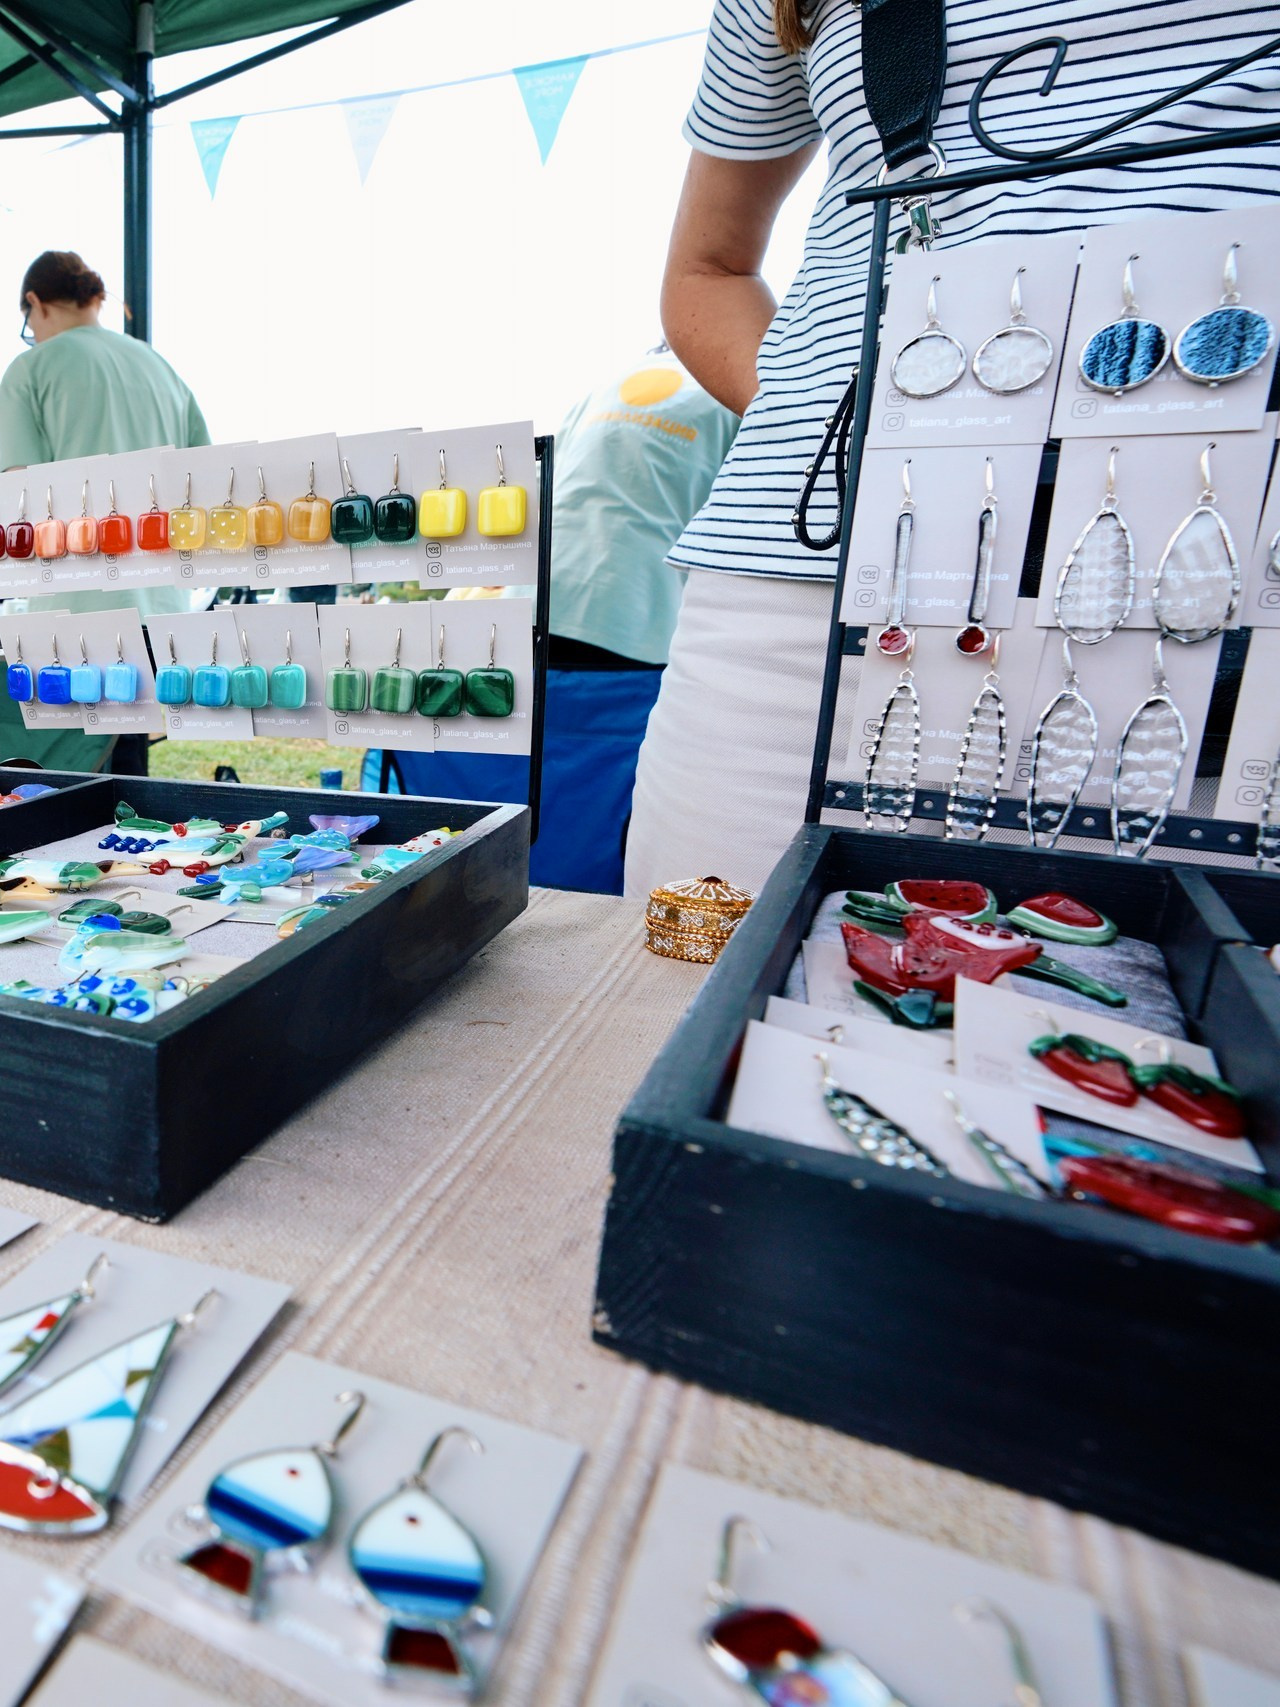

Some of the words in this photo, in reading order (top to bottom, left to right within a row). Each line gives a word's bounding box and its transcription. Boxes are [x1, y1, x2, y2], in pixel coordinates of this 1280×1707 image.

[1104, 397, 1225, 414] tatiana_glass_art
[909, 414, 1012, 428] tatiana_glass_art
[270, 545, 296, 555] Татьяна
[298, 541, 343, 553] Мартышина
[445, 544, 478, 554] Татьяна
[480, 541, 532, 554] Мартышина
[271, 563, 330, 575] tatiana_glass_art
[352, 558, 410, 569] atiana_glass_art
[445, 563, 515, 575] tatiana_glass_art
[195, 565, 248, 576] tatiana_glass_ar
[351, 725, 412, 738] tatiana_glass_art
[443, 729, 510, 741] tatiana_glass_art
